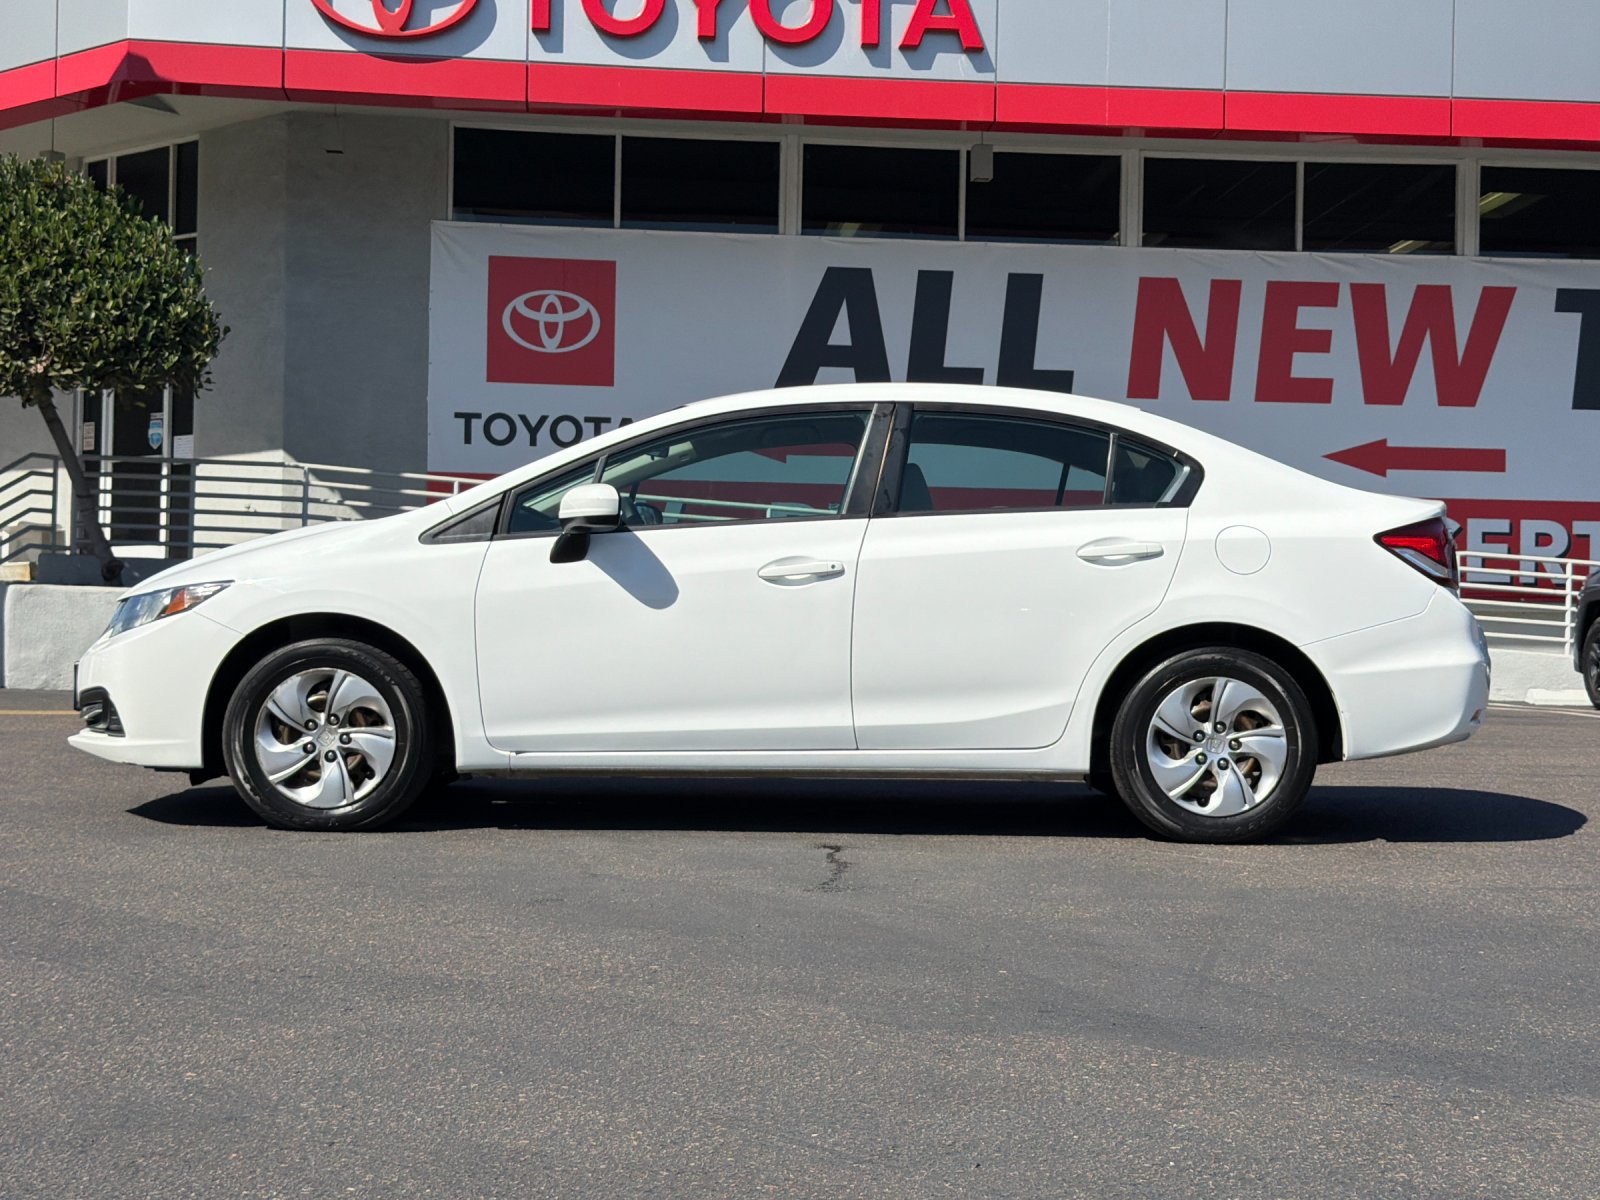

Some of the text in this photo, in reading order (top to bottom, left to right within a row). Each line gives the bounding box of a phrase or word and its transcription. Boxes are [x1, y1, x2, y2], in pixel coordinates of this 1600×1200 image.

[774, 266, 1075, 394] ALL
[1127, 277, 1517, 407] NEW
[454, 411, 635, 448] TOYOT
[1446, 517, 1600, 586] ERT
